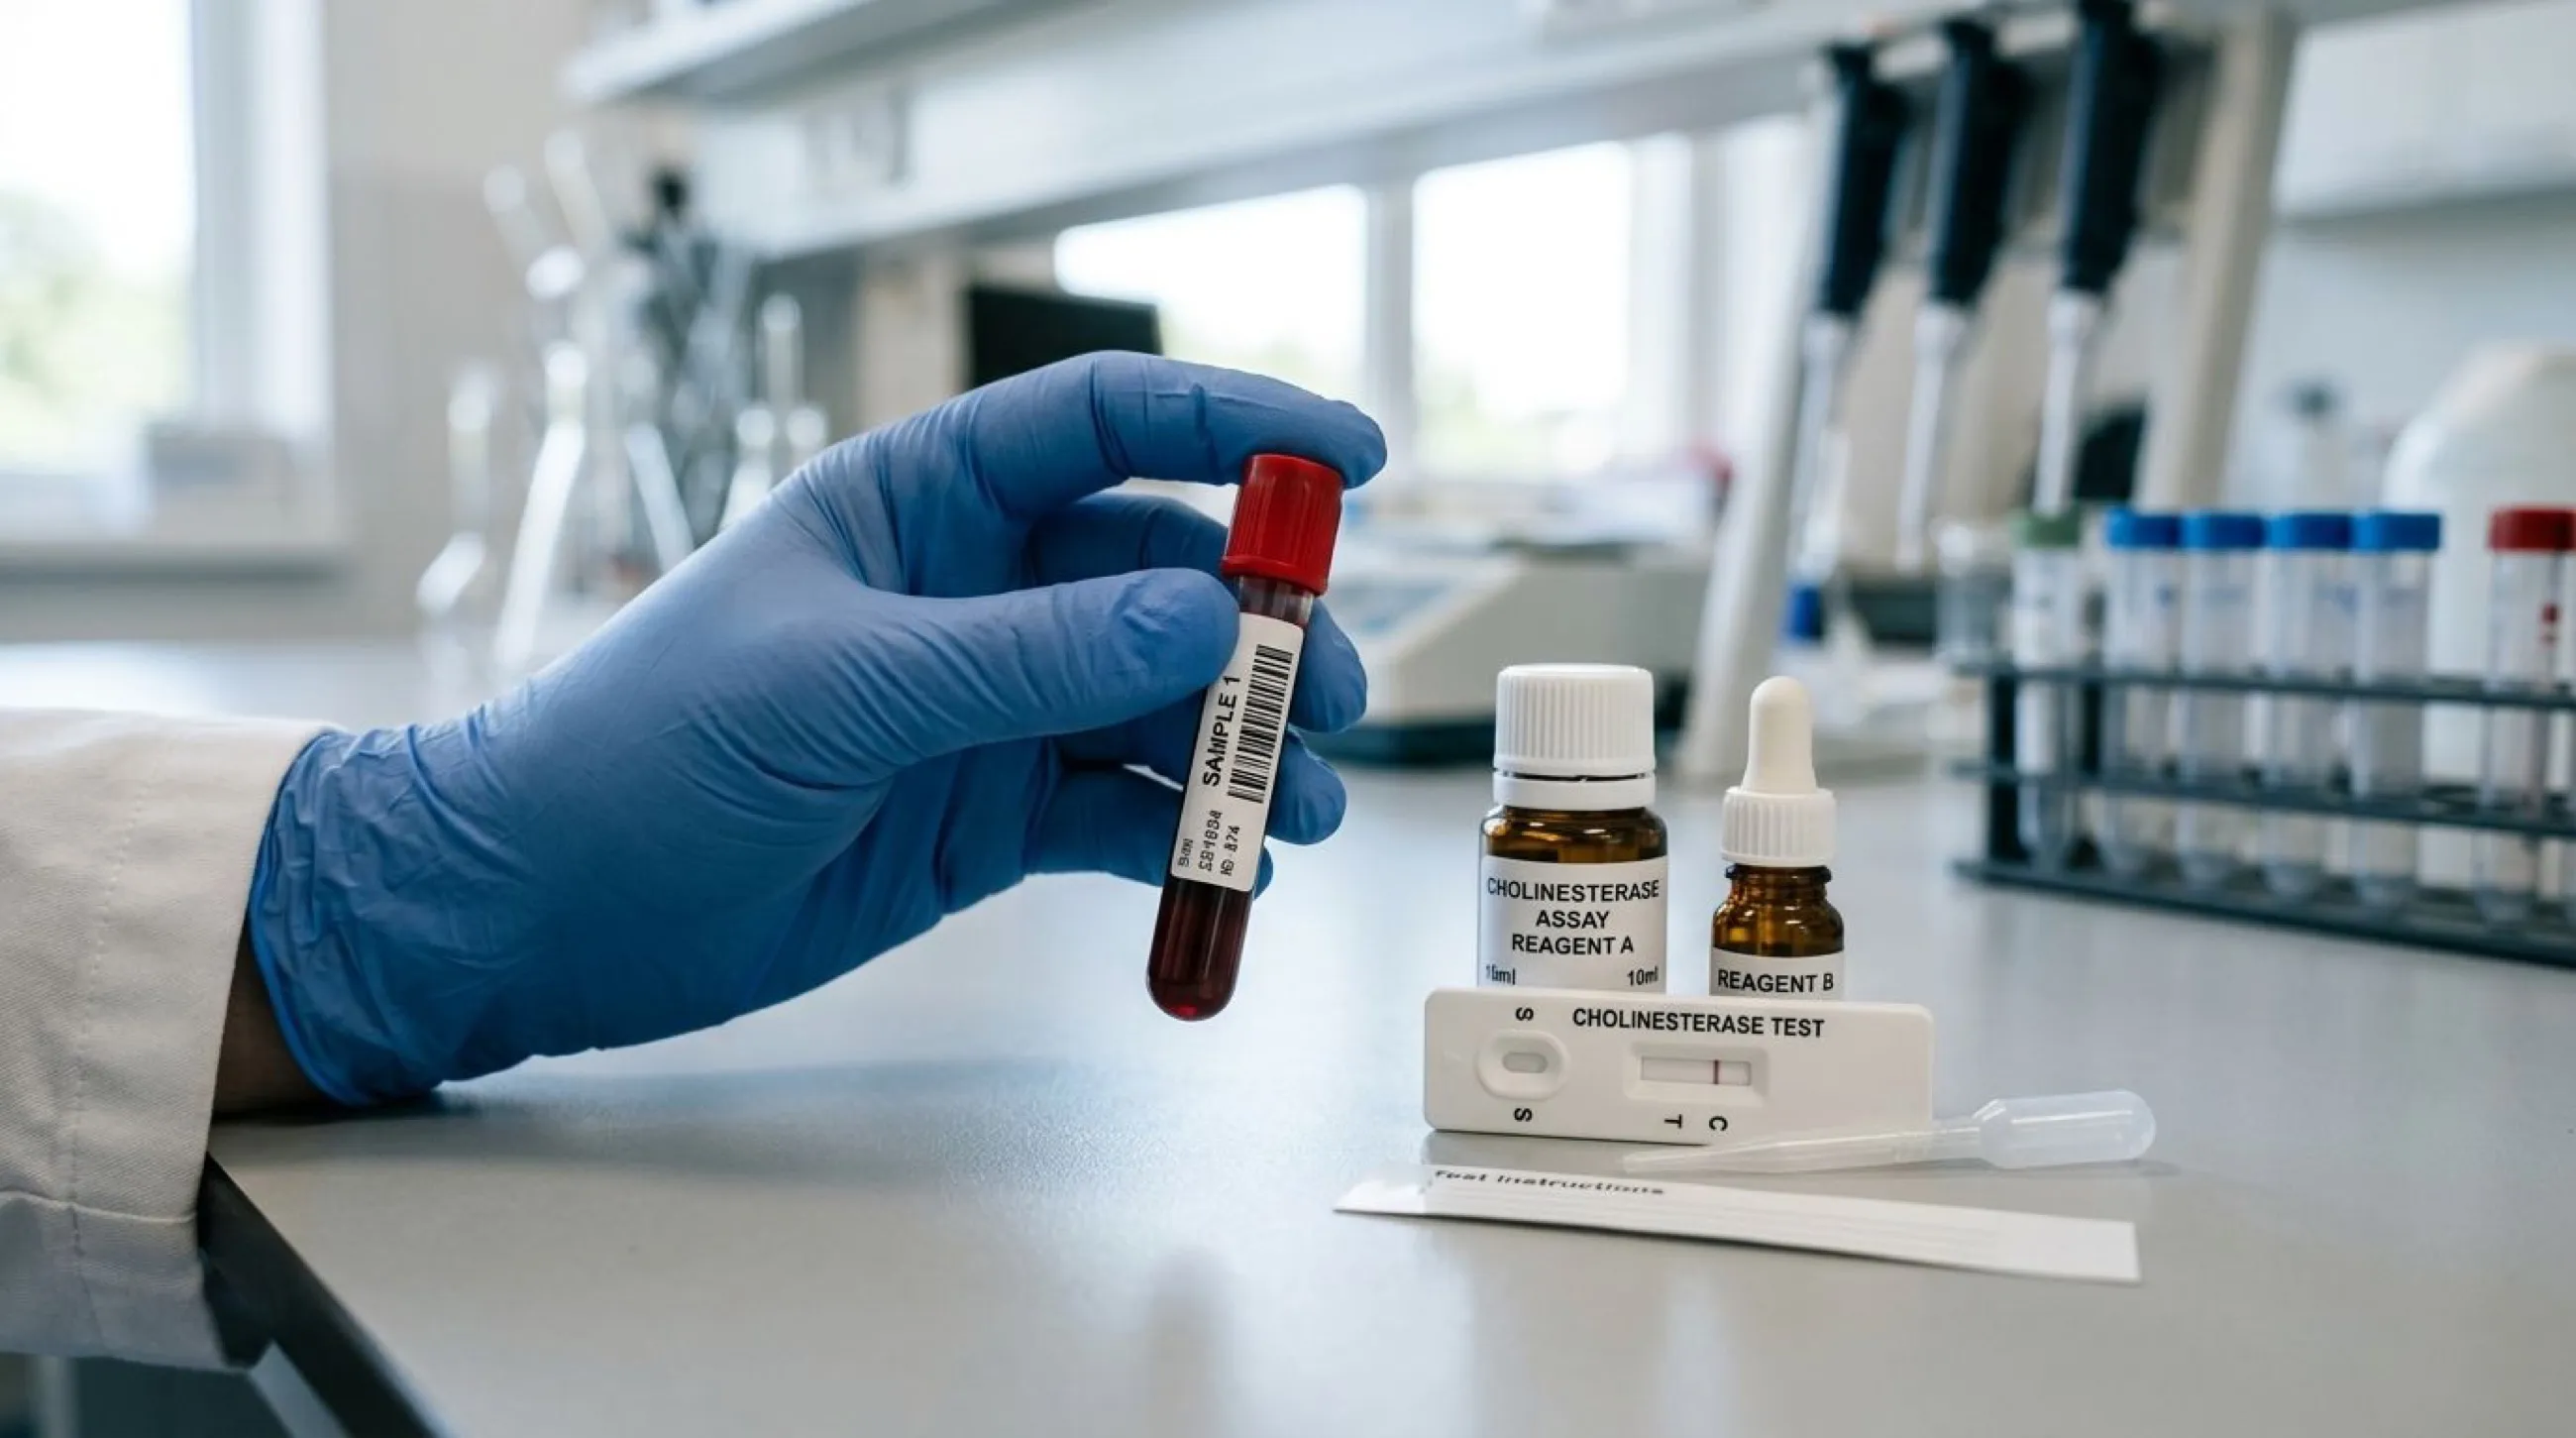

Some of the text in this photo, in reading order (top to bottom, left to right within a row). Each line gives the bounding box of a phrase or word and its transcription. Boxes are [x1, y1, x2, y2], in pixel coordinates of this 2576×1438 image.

[1203, 675, 1240, 786] SAMPLE 1
[1487, 878, 1660, 903] CHOLINESTERASE
[1536, 910, 1610, 929] ASSAY
[1512, 934, 1634, 954] REAGENT A
[1627, 965, 1659, 986] 10ml
[1718, 969, 1834, 992] REAGENT B
[1516, 1007, 1534, 1021] S
[1572, 1008, 1825, 1038] CHOLINESTERASE TEST
[1514, 1107, 1533, 1122] S
[1664, 1114, 1728, 1132] T C
